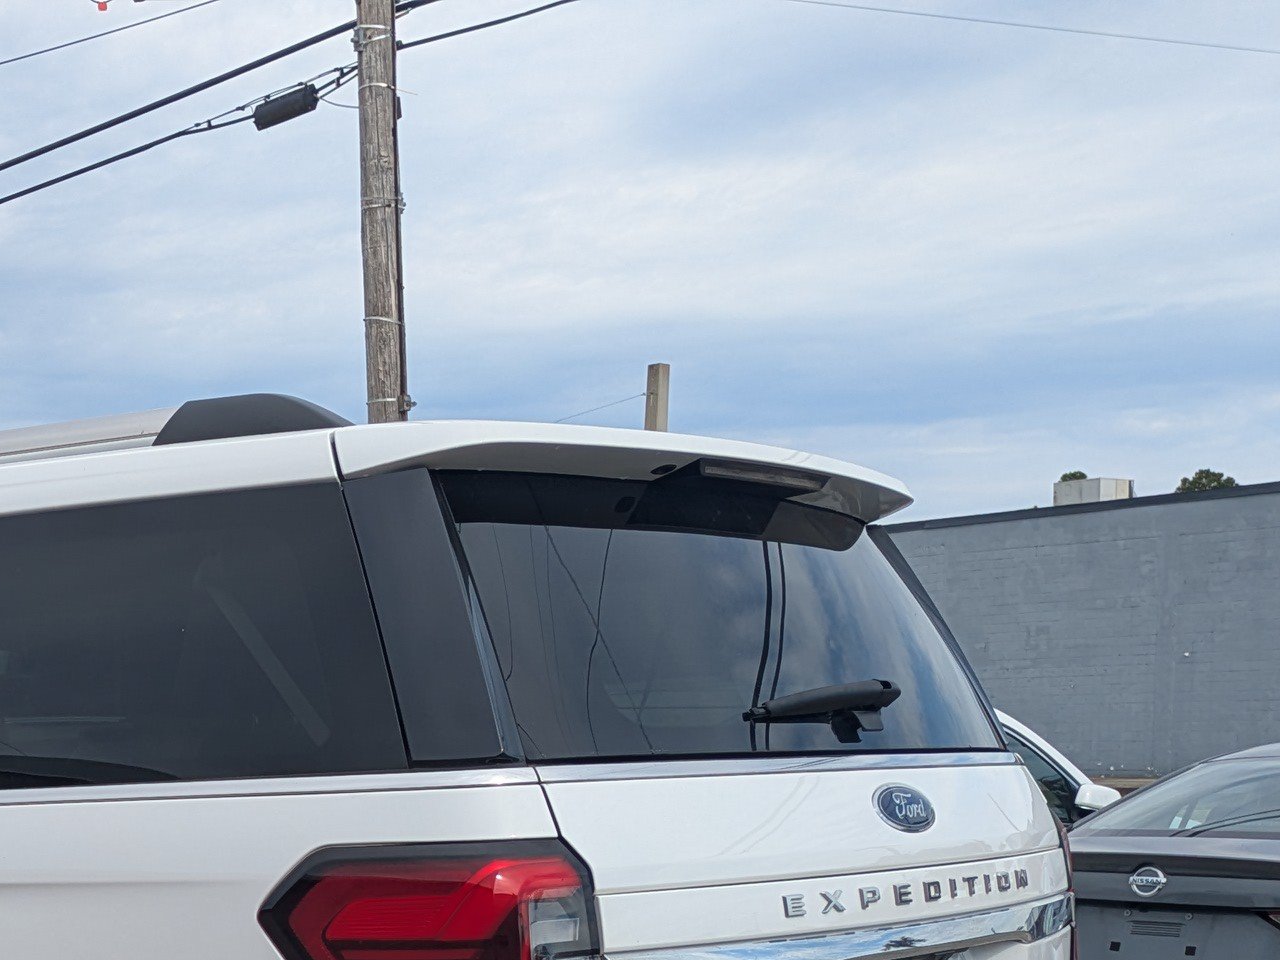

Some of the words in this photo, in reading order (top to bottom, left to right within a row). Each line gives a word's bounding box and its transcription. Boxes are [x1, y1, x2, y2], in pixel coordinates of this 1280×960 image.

[892, 792, 927, 819] Ford
[781, 868, 1029, 918] EXPEDITION
[1132, 876, 1162, 886] NISSAN
